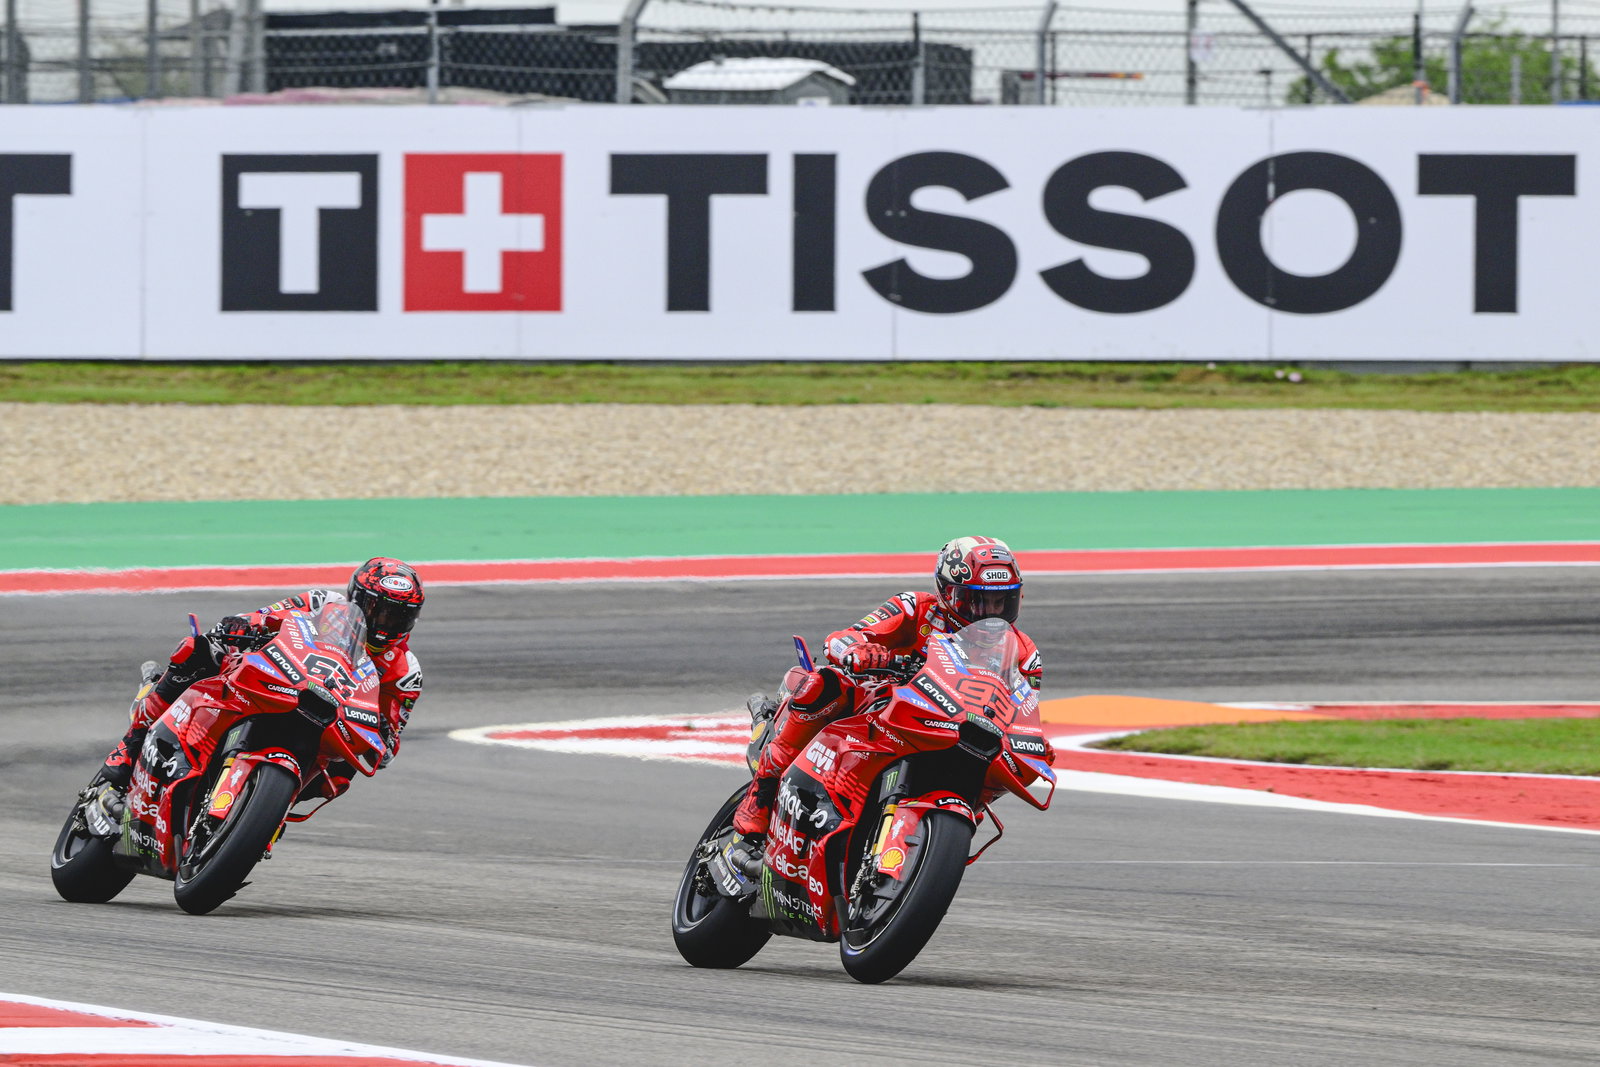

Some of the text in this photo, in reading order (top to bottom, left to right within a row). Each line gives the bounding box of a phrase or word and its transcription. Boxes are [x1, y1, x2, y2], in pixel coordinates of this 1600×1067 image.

[609, 150, 1577, 315] TISSOT
[986, 571, 1008, 580] SHOEI
[259, 664, 275, 675] TIM
[266, 645, 301, 681] Lenovo
[267, 684, 298, 696] CARRERA
[916, 676, 957, 714] Lenovo
[911, 698, 929, 709] TIM
[344, 706, 378, 724] Lenovo
[872, 720, 905, 748] Audi Sport
[924, 720, 959, 731] CARRERA
[1010, 738, 1045, 752] Lenovo
[805, 740, 836, 771] GIVI
[775, 853, 809, 880] elica
